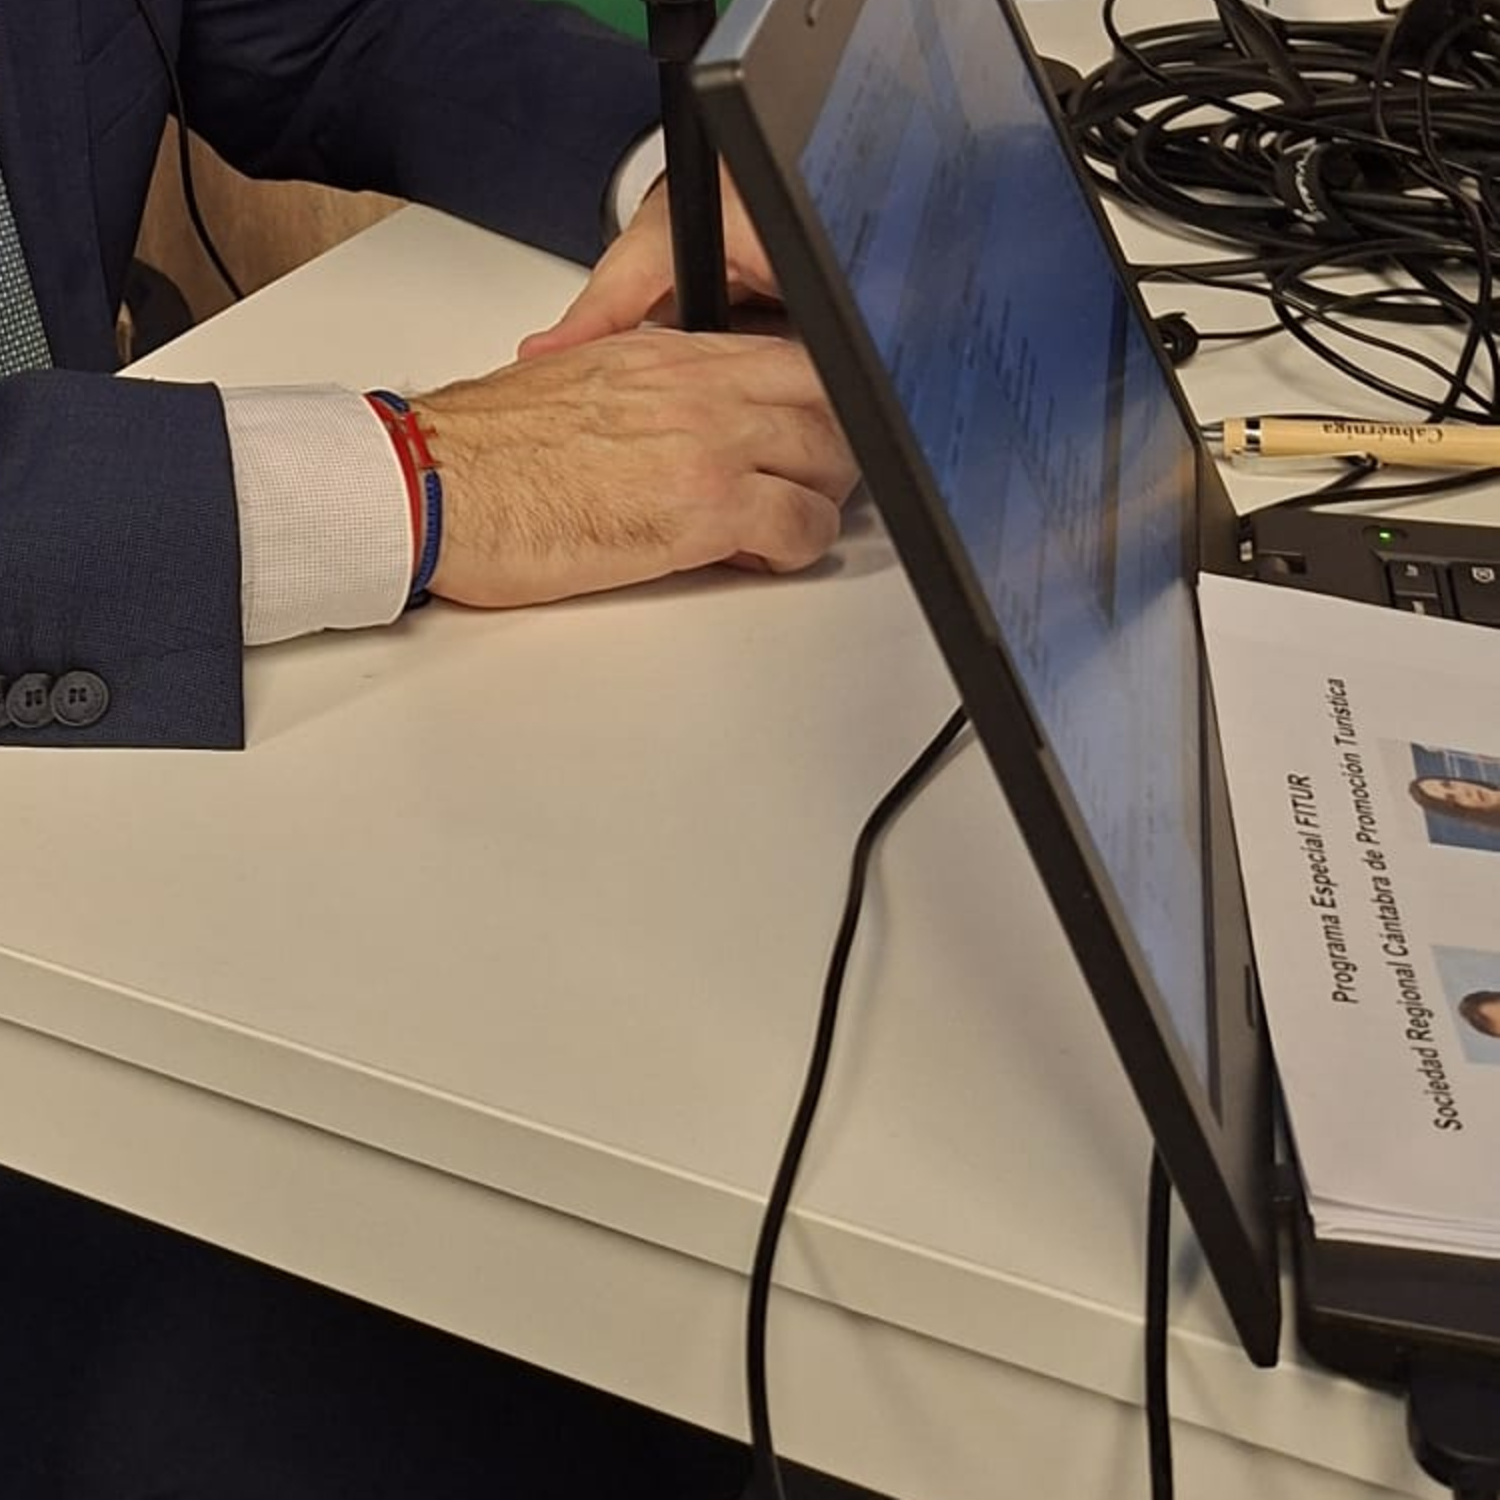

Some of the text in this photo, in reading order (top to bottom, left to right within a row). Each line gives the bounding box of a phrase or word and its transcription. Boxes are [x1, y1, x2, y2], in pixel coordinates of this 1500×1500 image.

[1286, 773, 1360, 1004] Programa Especial FITUR
[1324, 677, 1463, 1132] Sociedad Regional Cántabra de Promoción Turística
